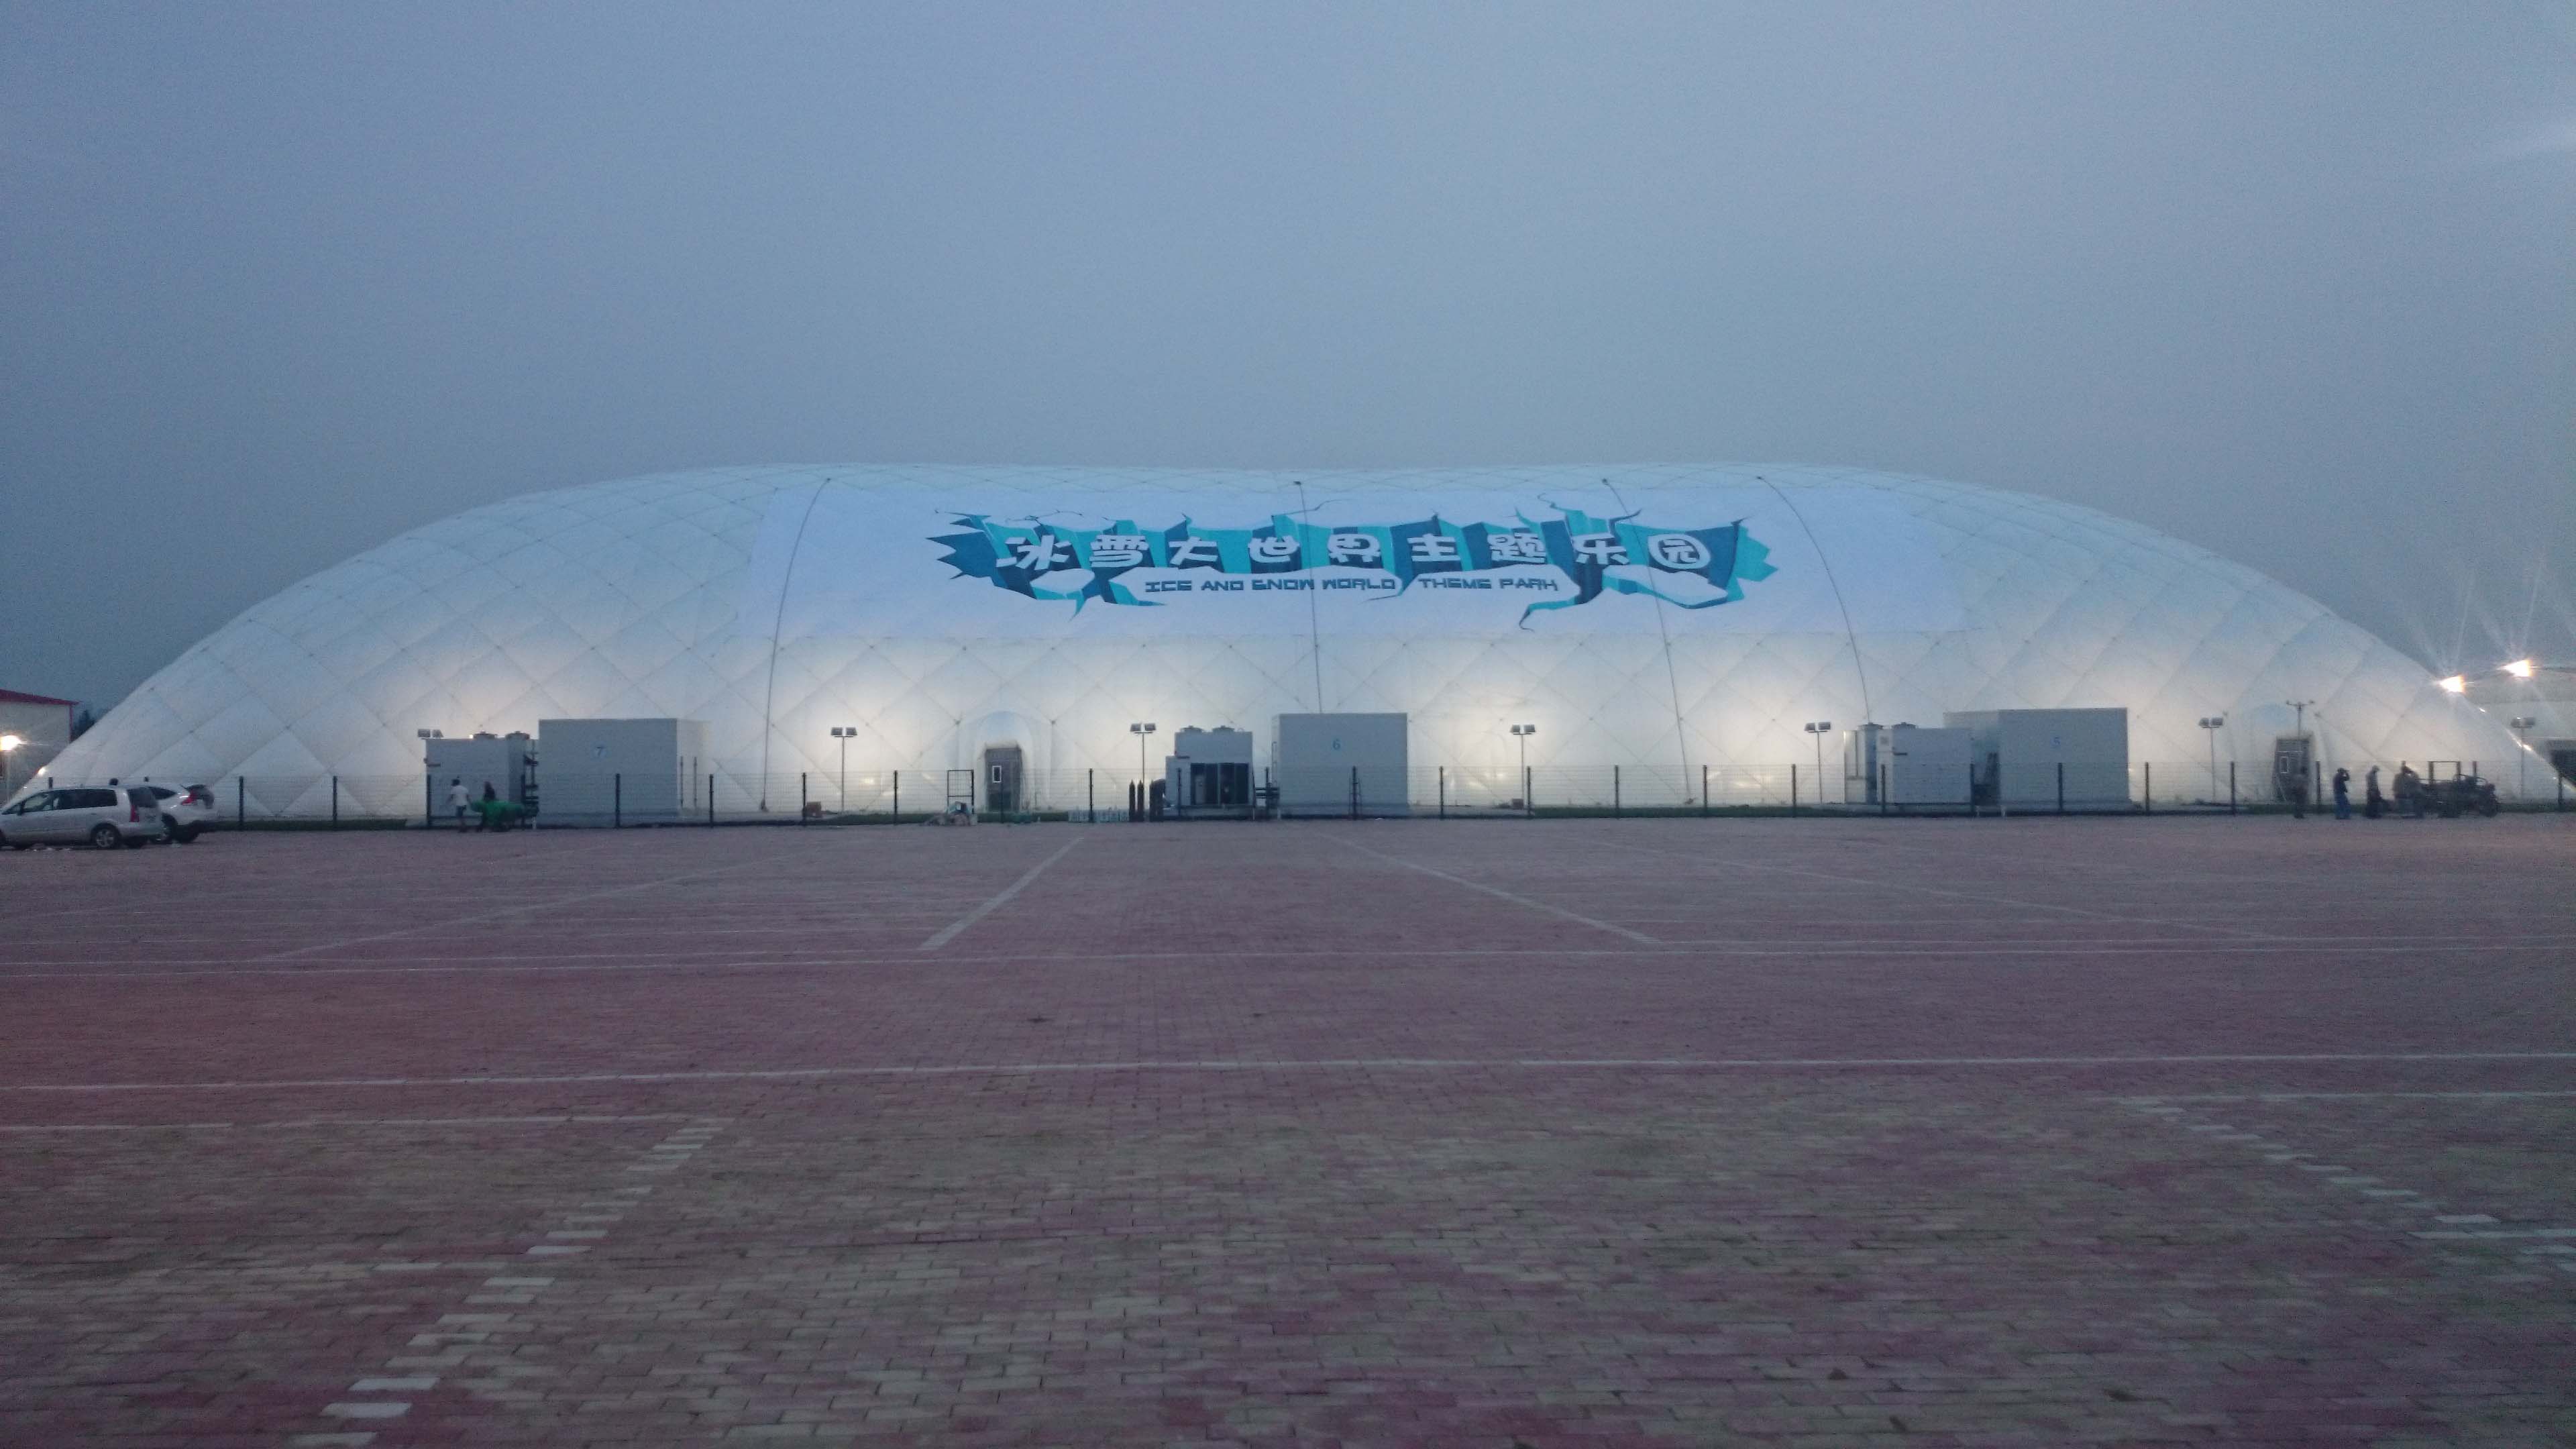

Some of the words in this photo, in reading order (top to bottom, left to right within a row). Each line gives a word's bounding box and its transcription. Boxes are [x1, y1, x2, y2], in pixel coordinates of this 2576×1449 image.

[996, 533, 1710, 570] 冰雪大世界主题乐园
[1145, 580, 1192, 592] ICE
[1201, 580, 1244, 591] AND
[1252, 579, 1314, 590] SNOW
[1322, 578, 1395, 590] WORLD
[1418, 578, 1492, 590] THEME
[1499, 578, 1558, 591] PARK
[1332, 738, 1341, 751] 6
